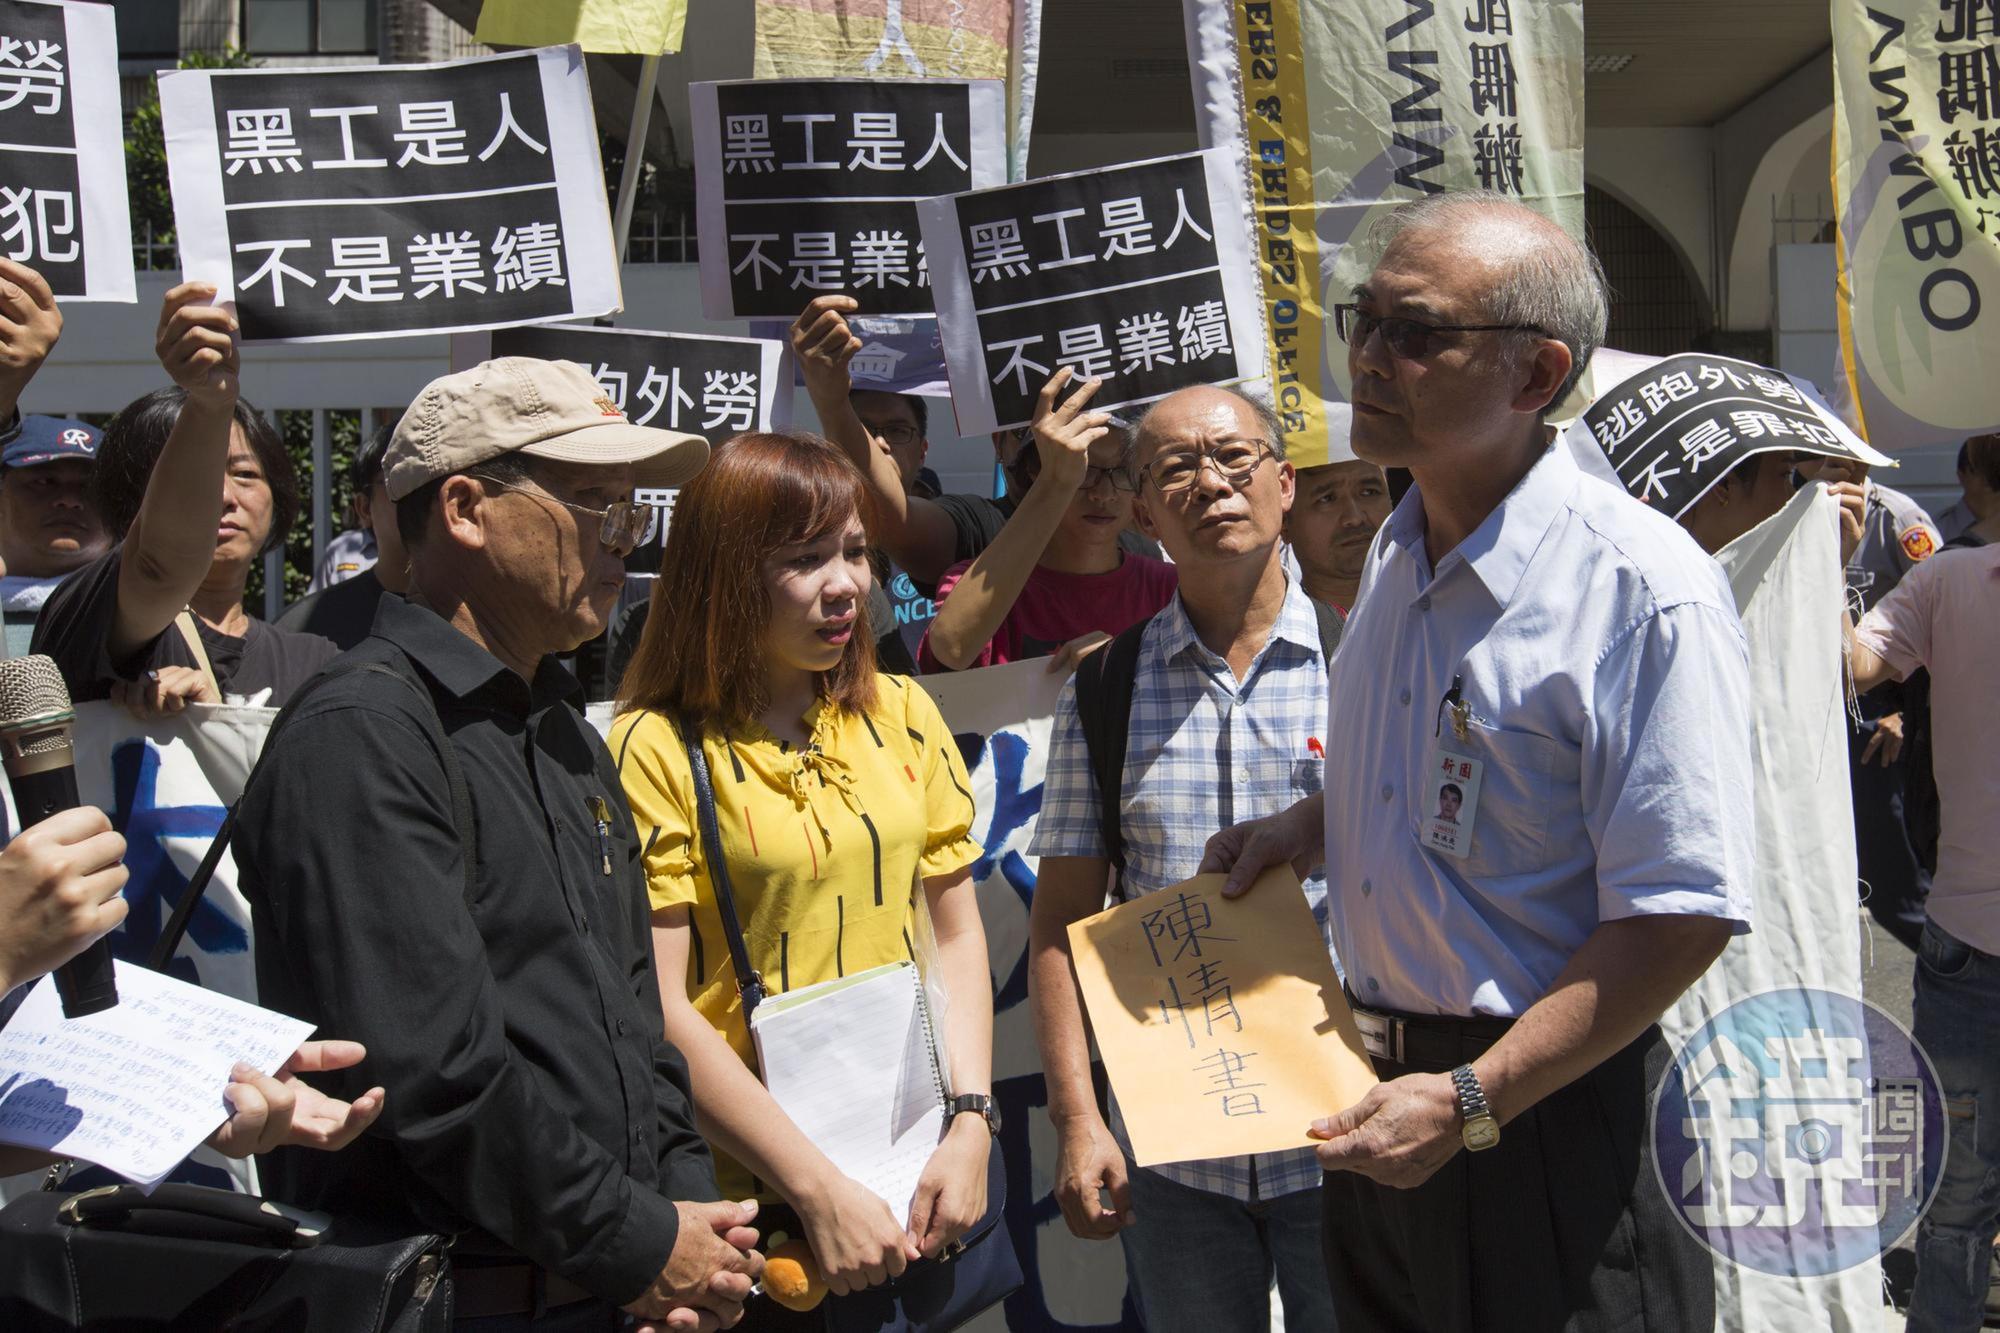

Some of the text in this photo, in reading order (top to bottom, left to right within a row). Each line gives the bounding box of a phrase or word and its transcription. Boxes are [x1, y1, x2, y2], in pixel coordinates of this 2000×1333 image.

[0, 36, 64, 115] 勞
[225, 92, 548, 176] 黑工是人
[724, 112, 968, 175] 黑工是人
[0, 186, 80, 263] 犯
[235, 221, 567, 307] 不是業績
[730, 230, 931, 291] 不是業
[969, 188, 1212, 285] 黑工是人
[986, 300, 1232, 396] 不是業績
[1594, 364, 1803, 456] 逃跑外勞
[1627, 410, 1848, 500] 不是罪犯
[1141, 893, 1266, 1117] 陳情書
